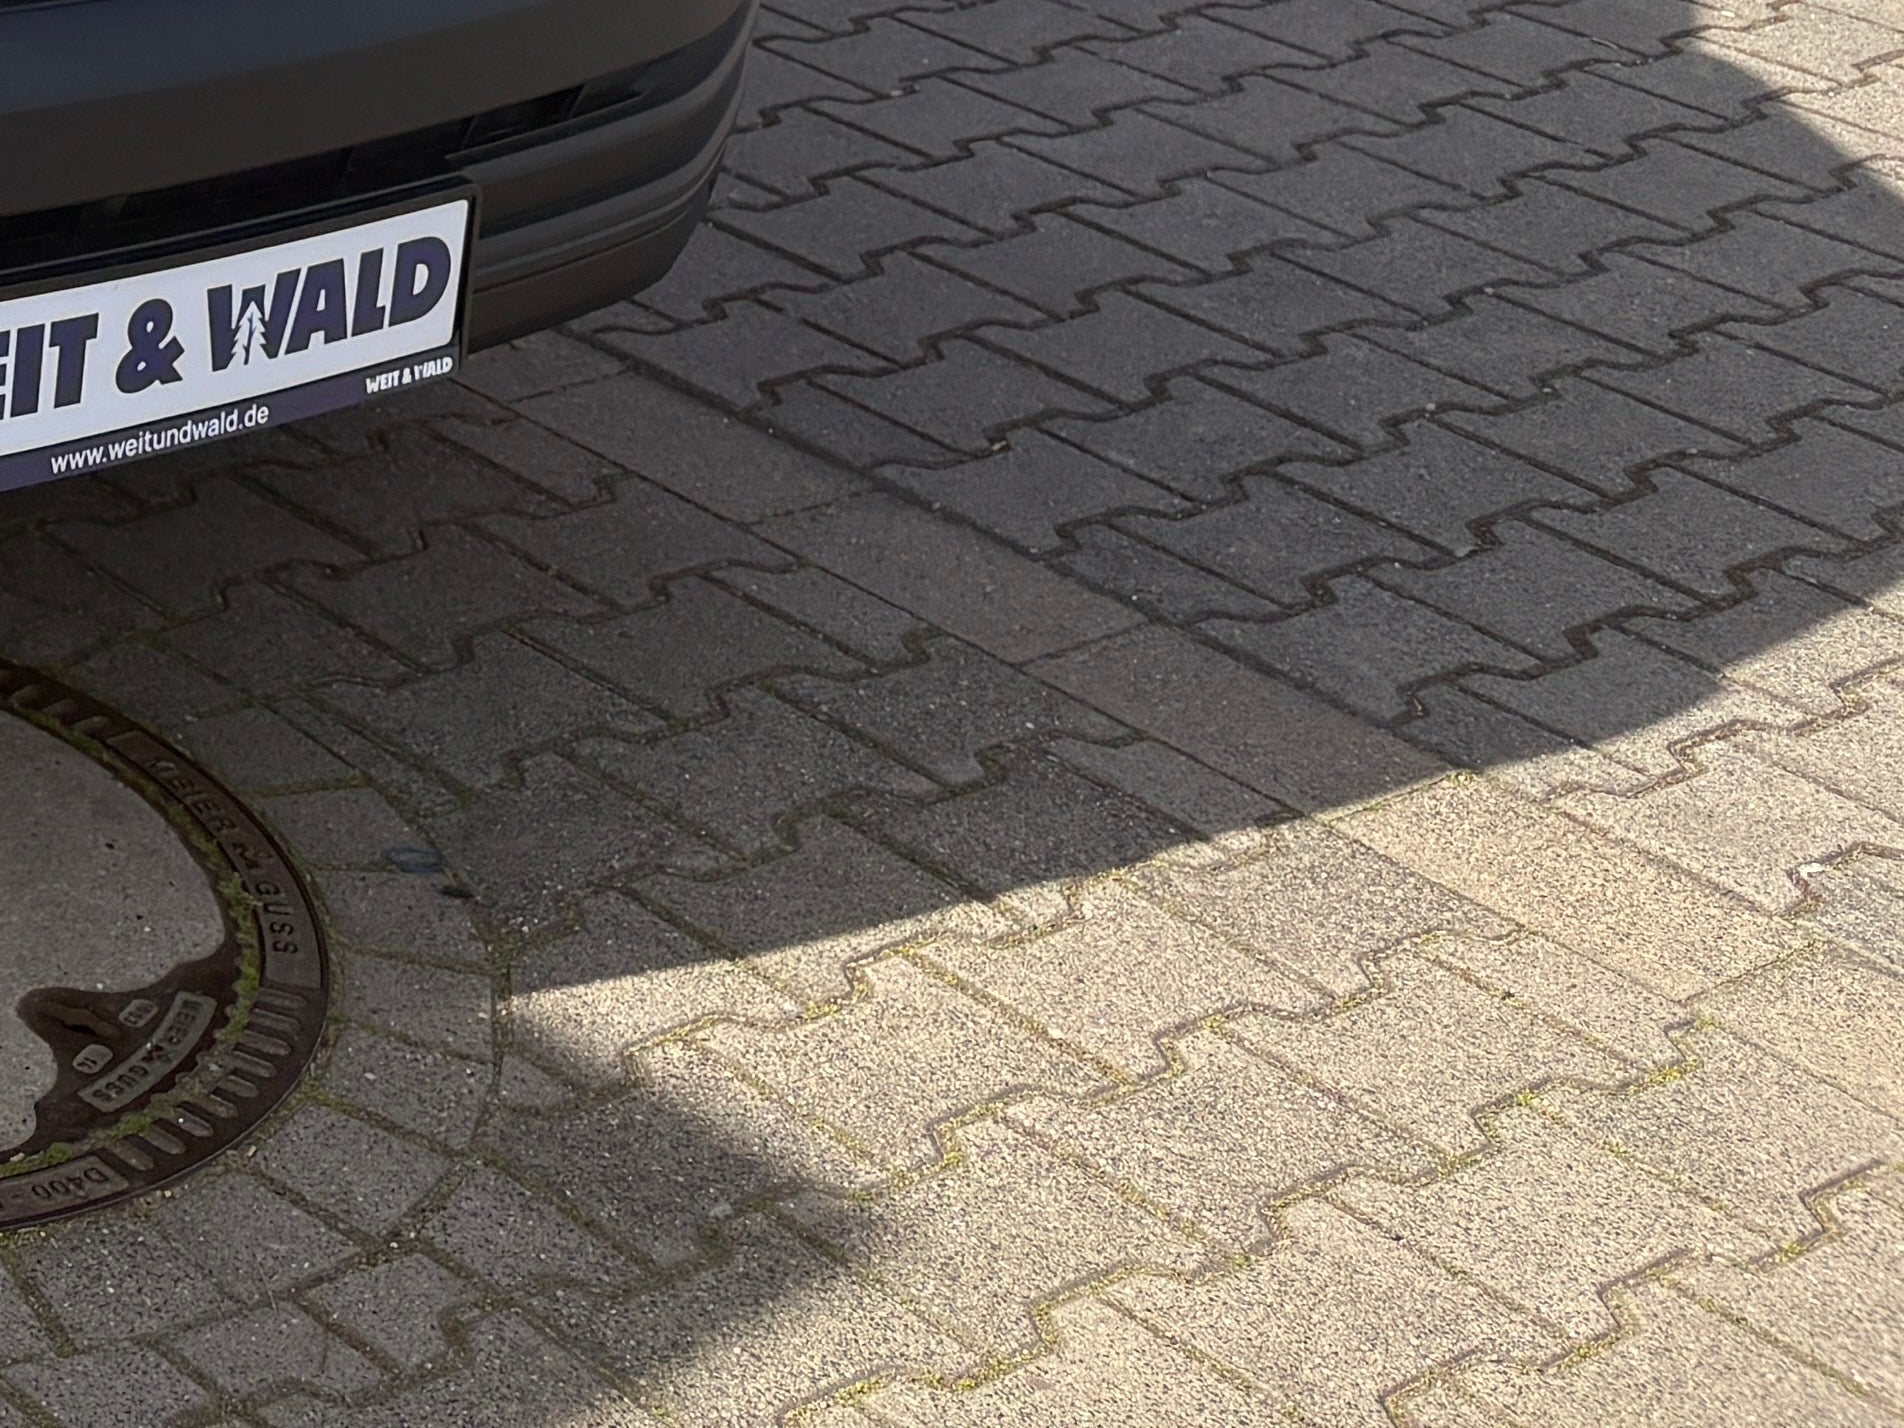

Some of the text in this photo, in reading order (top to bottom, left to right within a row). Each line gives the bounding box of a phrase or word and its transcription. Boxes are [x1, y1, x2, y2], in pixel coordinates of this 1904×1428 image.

[115, 297, 185, 393] &
[205, 236, 452, 373] WALD
[365, 356, 454, 394] WEIT & WALD
[49, 403, 270, 474] www.weitundwald.de
[255, 879, 299, 956] GUSS
[31, 1166, 108, 1200] D400
